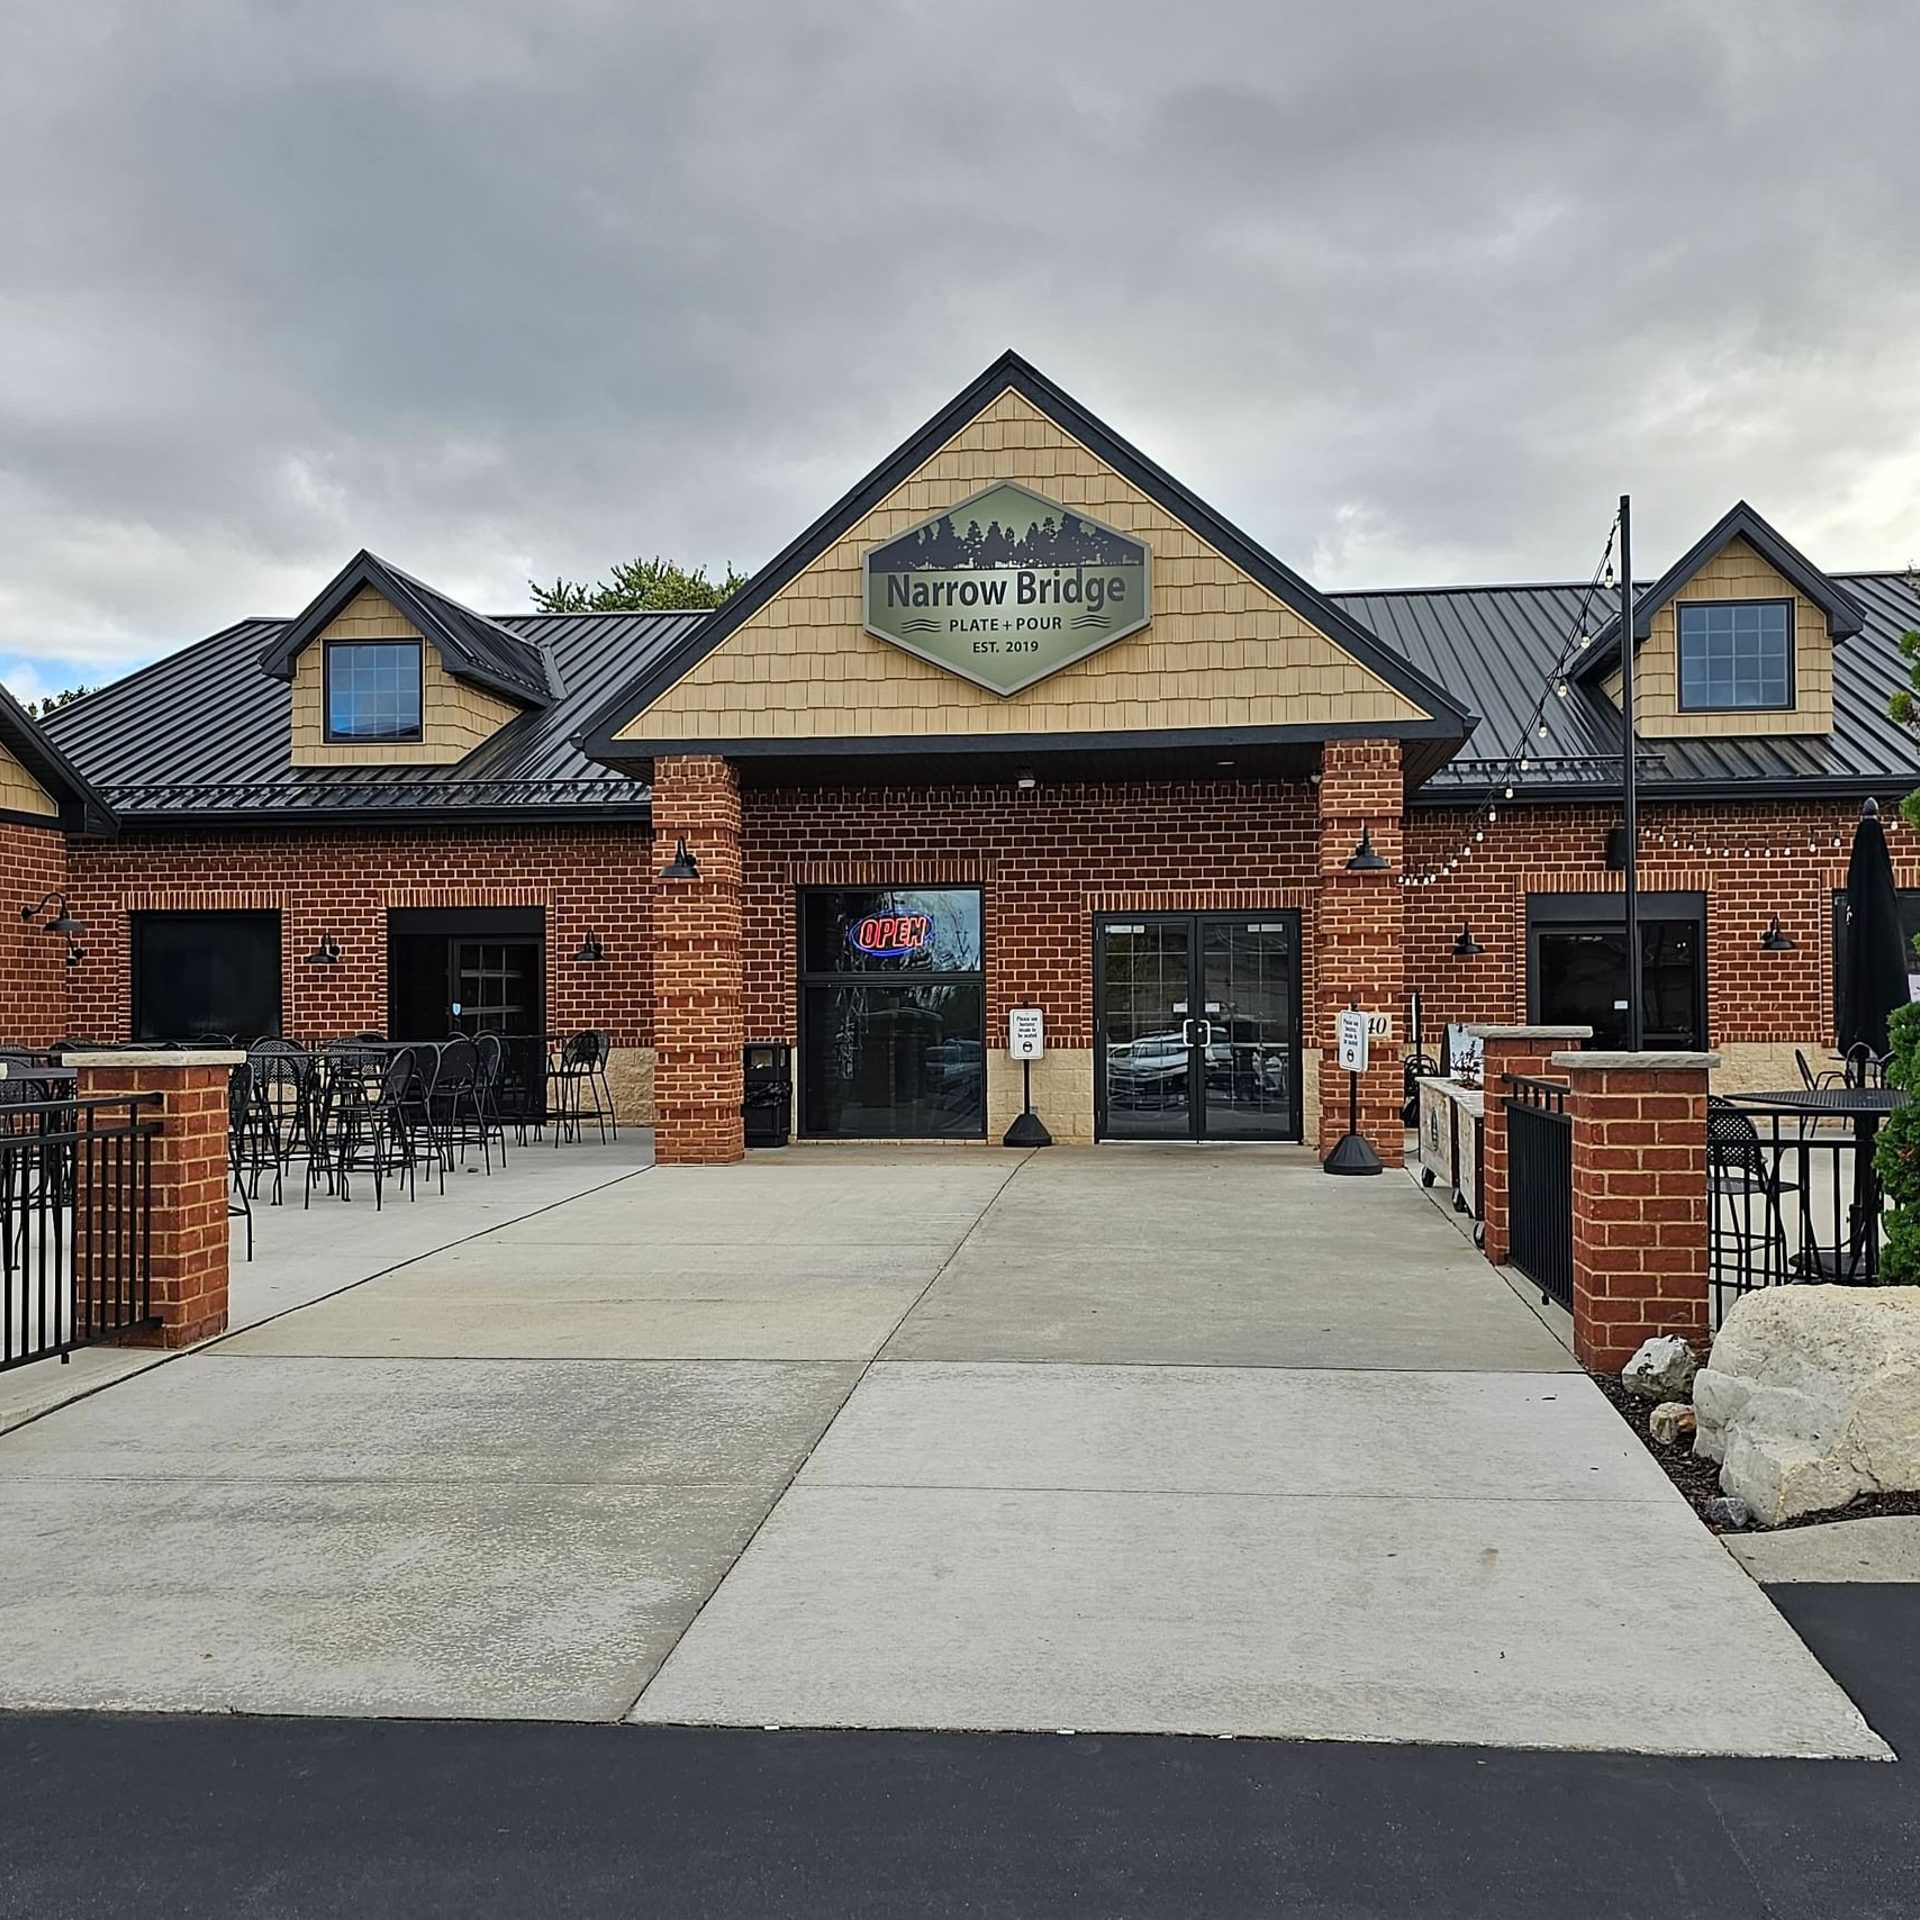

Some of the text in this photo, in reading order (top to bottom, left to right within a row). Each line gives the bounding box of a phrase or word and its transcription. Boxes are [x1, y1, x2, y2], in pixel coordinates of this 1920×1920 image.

[887, 569, 1126, 612] Narrow Bridge
[950, 618, 999, 632] PLATE
[1016, 617, 1062, 631] POUR
[973, 640, 1039, 653] EST. 2019
[860, 917, 926, 949] OPEN
